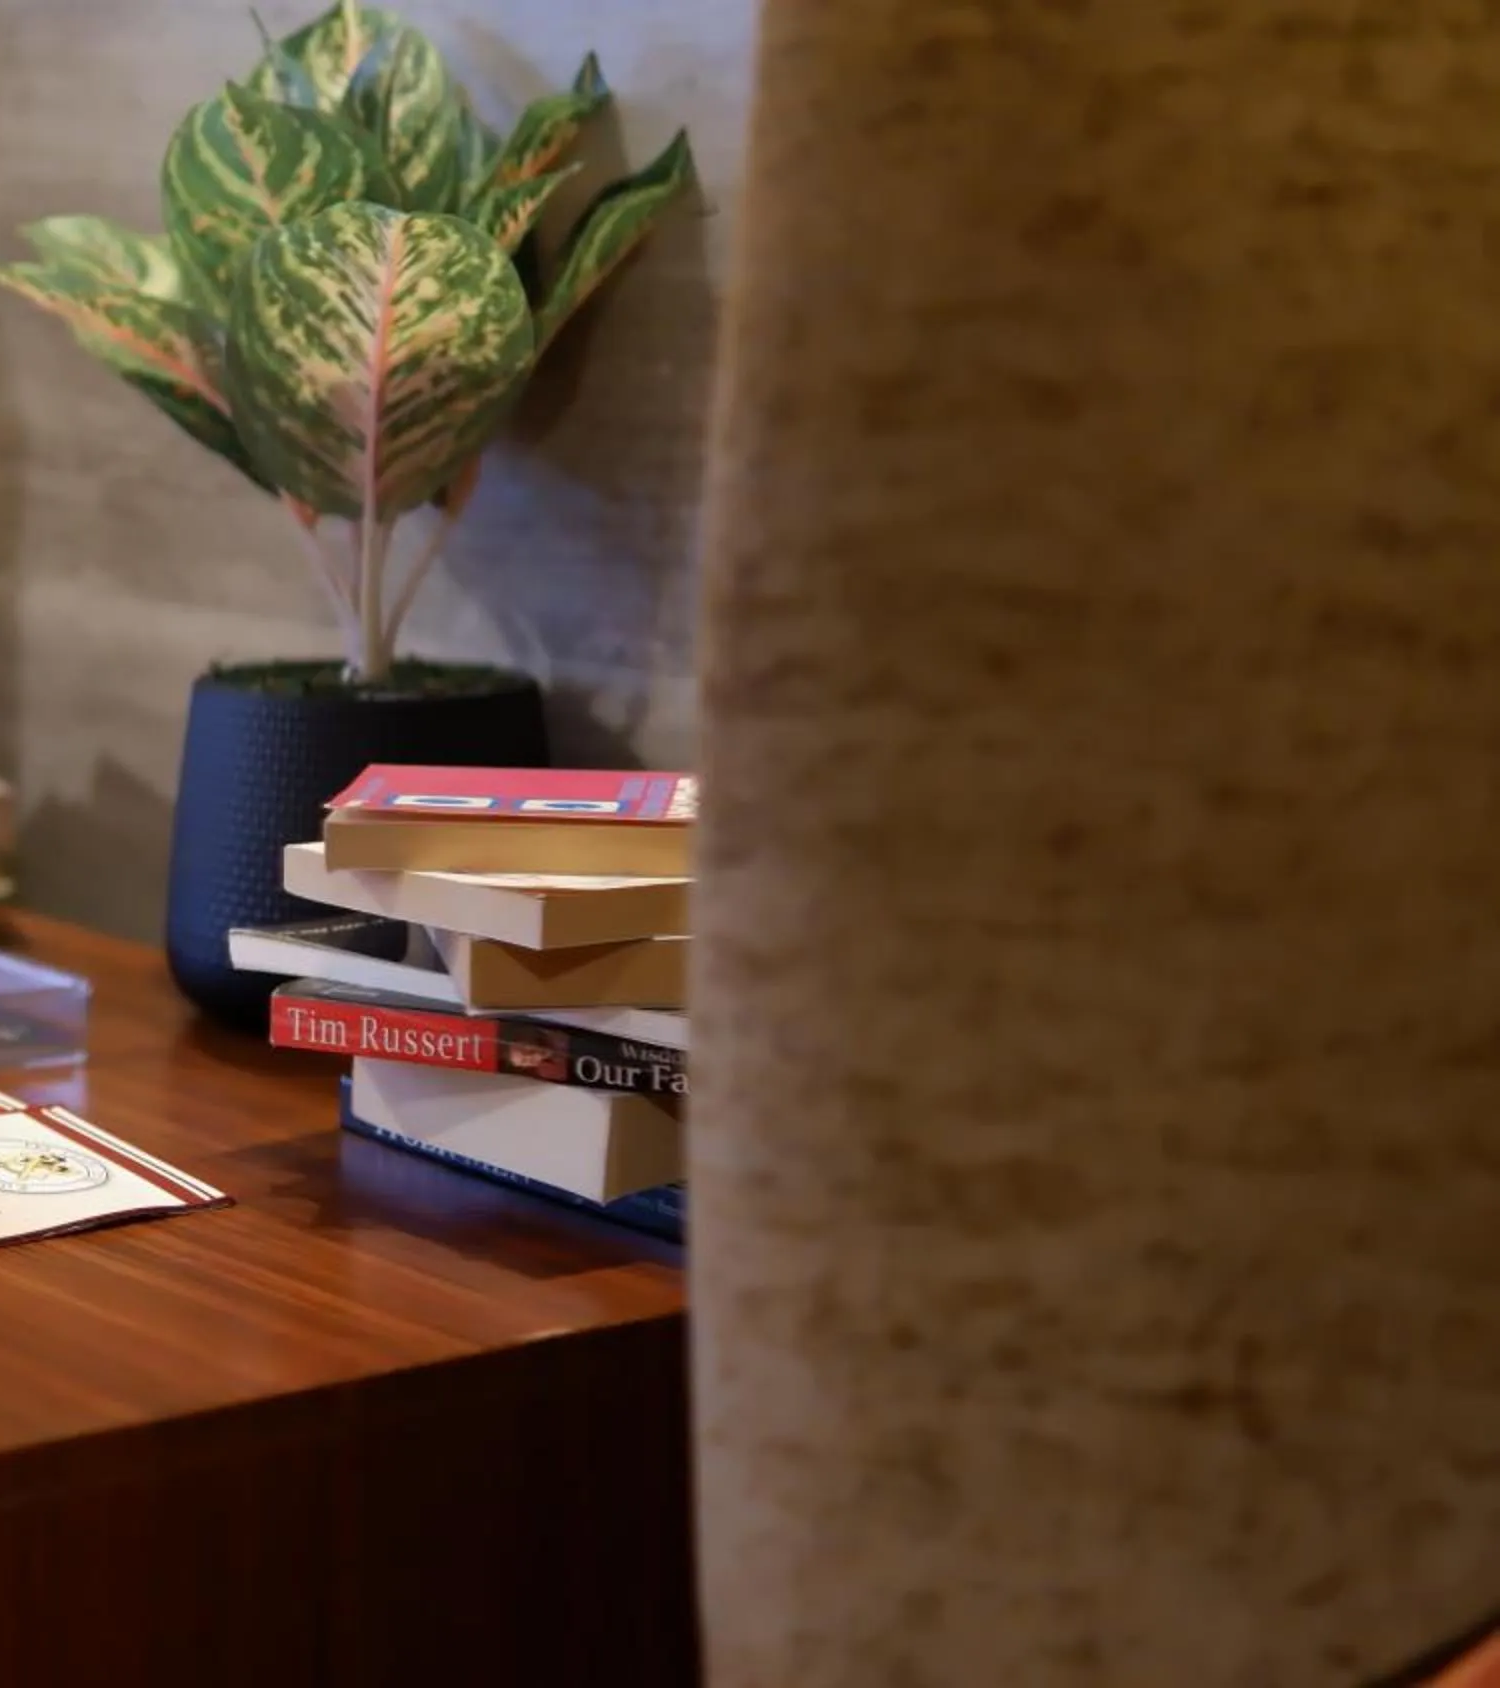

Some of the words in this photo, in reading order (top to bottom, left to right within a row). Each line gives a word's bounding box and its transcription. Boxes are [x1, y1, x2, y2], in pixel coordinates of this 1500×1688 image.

[287, 1007, 348, 1048] Tim
[359, 1015, 482, 1064] Russert
[576, 1055, 641, 1087] Our
